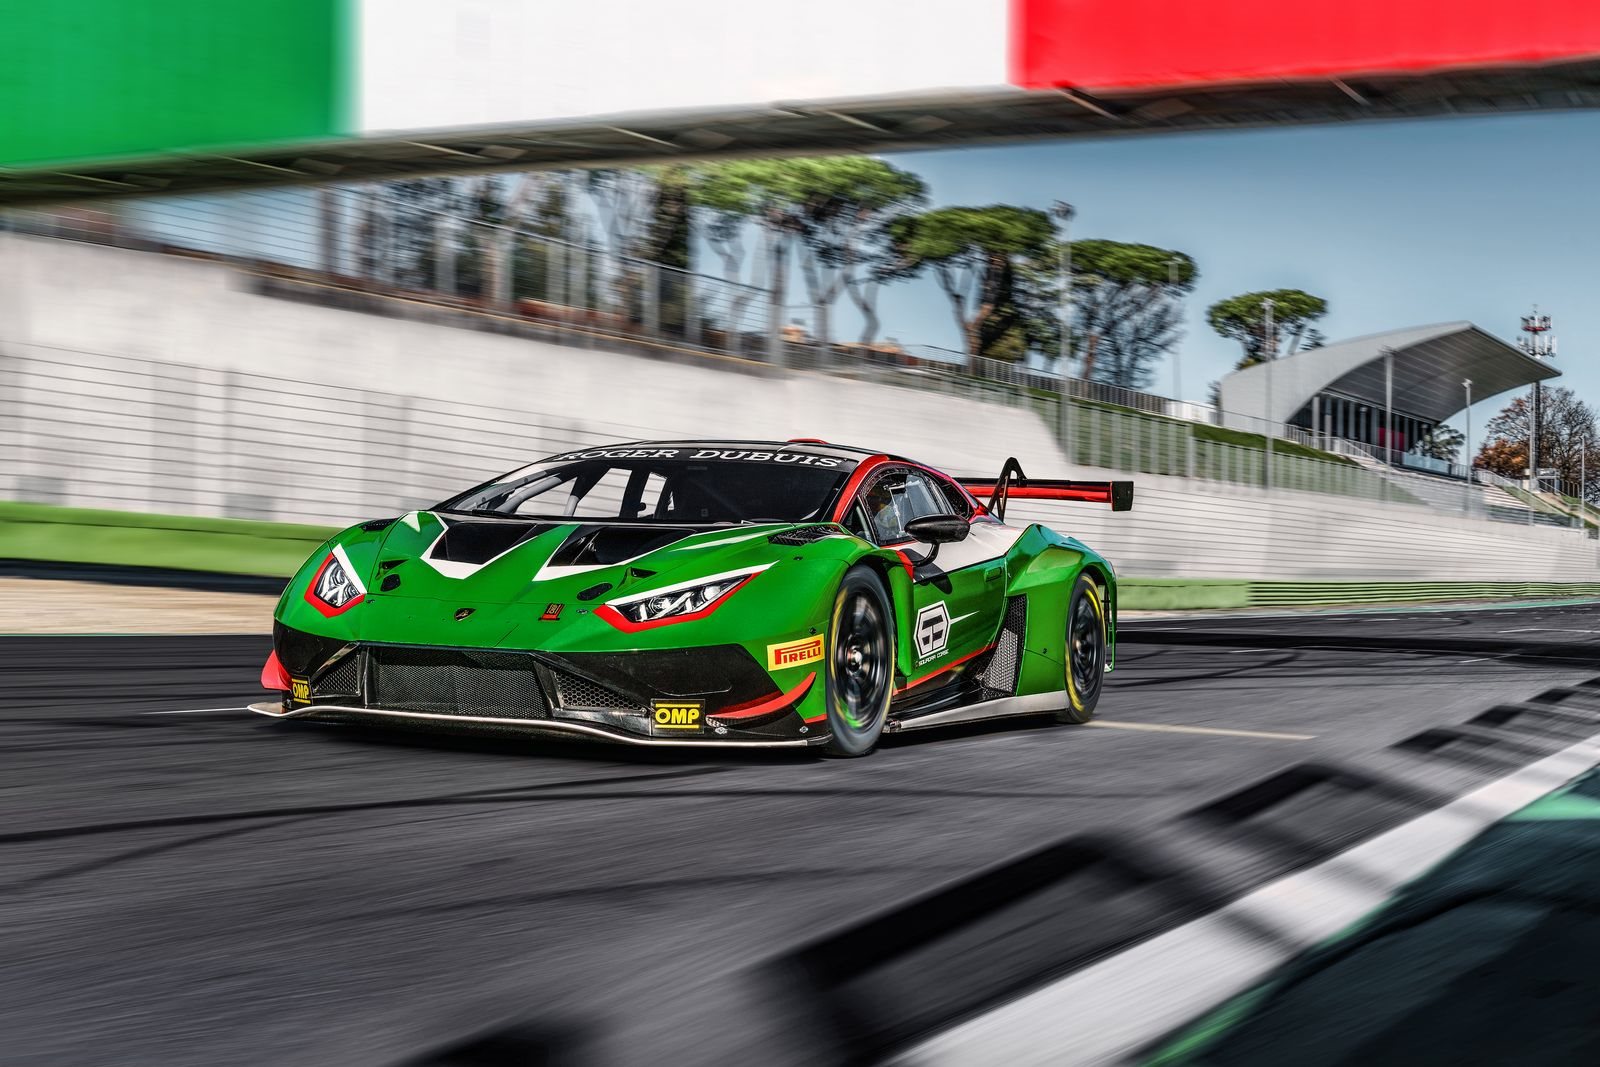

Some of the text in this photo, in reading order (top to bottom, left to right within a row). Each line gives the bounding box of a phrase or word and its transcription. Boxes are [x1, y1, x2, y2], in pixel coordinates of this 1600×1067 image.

[689, 449, 842, 467] DUBUIS
[774, 640, 821, 665] PIRELLI
[292, 683, 310, 699] OMP
[655, 708, 700, 724] OMP
